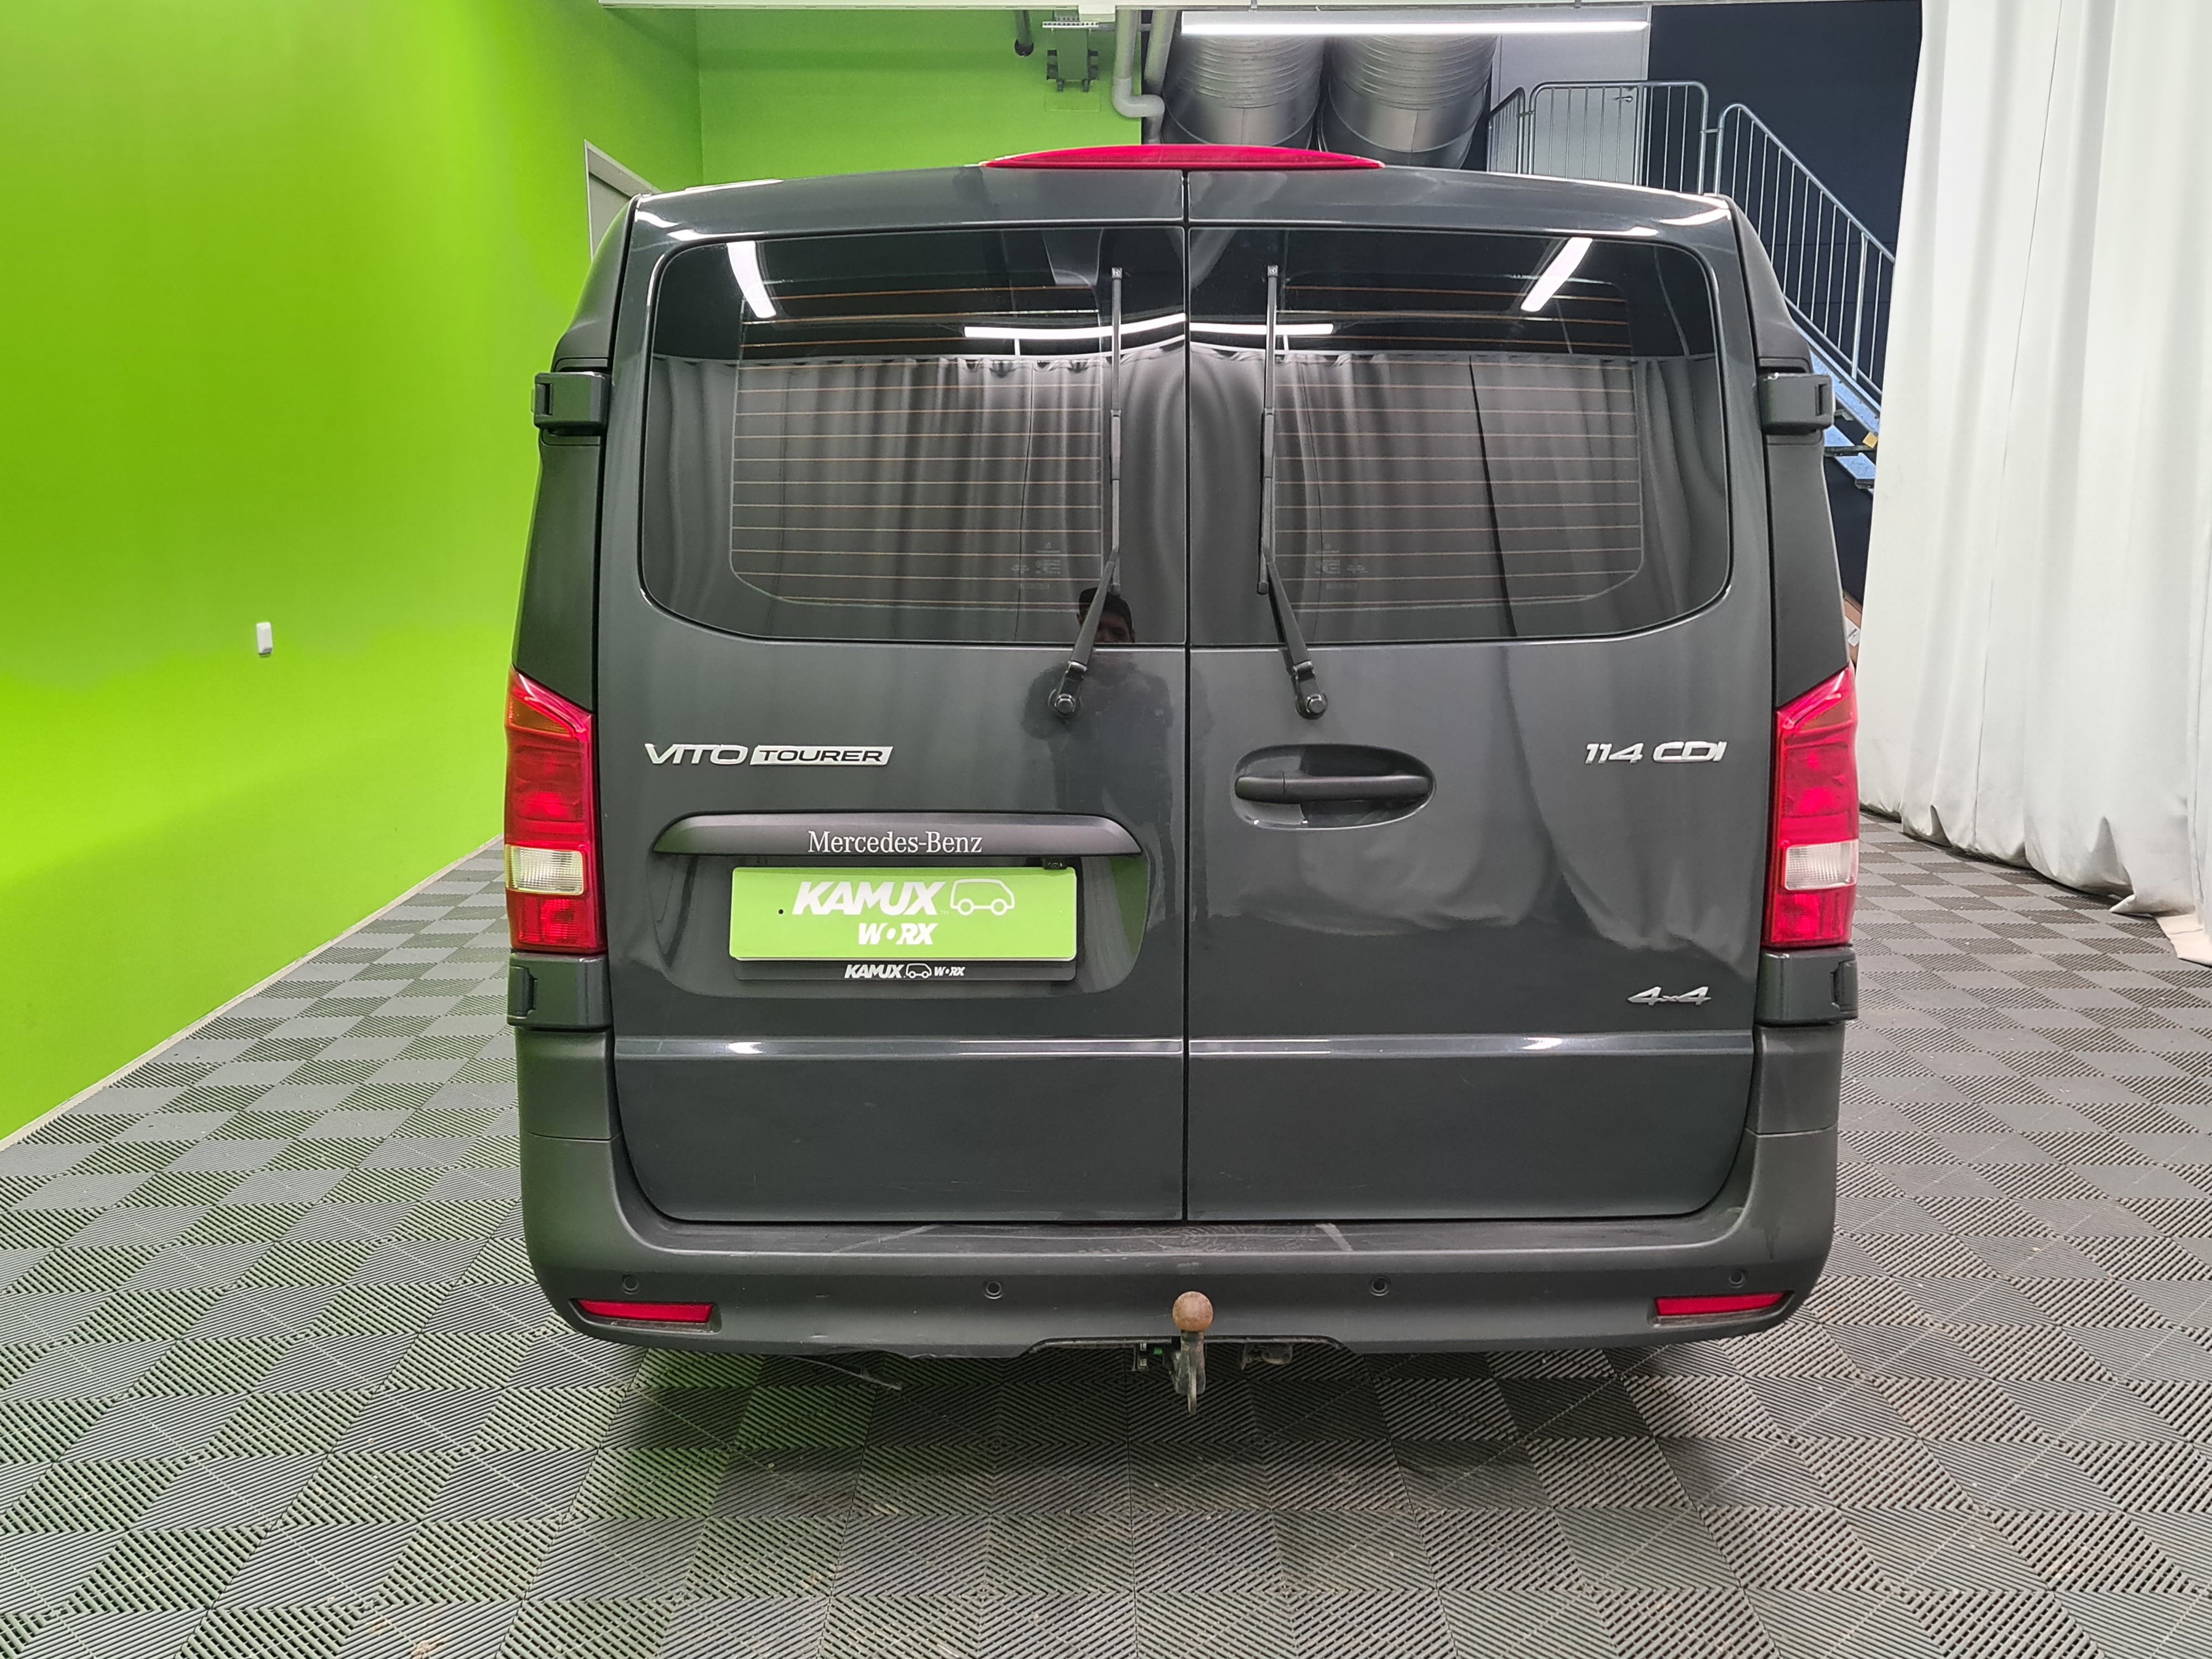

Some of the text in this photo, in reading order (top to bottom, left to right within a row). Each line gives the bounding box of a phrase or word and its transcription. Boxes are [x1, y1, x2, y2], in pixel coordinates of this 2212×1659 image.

[644, 743, 884, 765] VITO TOURER
[1584, 740, 1728, 764] 114 CDI
[807, 830, 983, 853] Mercedes-Benz
[791, 881, 946, 916] KAMUX
[844, 964, 905, 979] KAMUX
[1627, 986, 1712, 1006] 4x4
